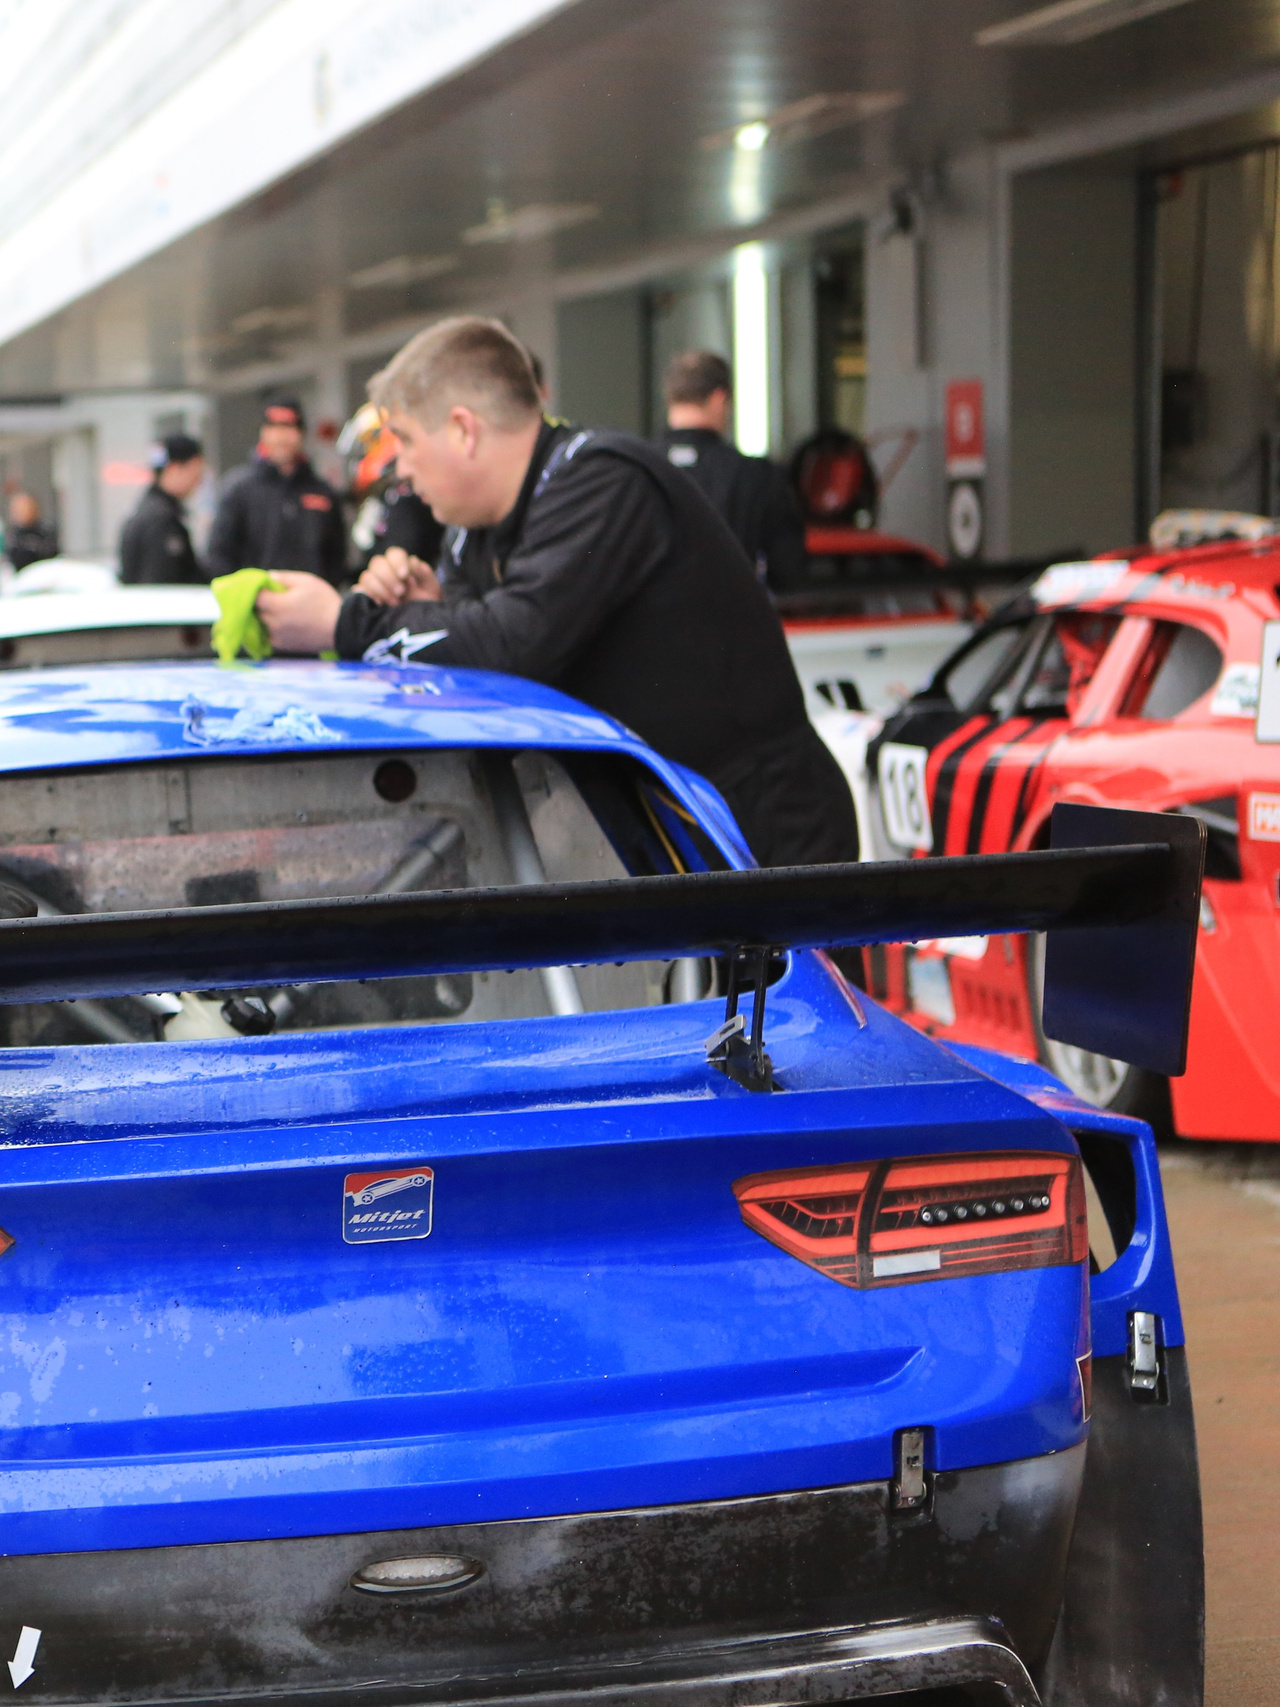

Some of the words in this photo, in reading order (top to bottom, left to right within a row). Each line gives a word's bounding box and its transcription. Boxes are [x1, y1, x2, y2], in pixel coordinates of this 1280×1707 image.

[890, 758, 923, 834] 18
[348, 1209, 425, 1224] Mitjet
[353, 1223, 418, 1233] MOTORSPORT
